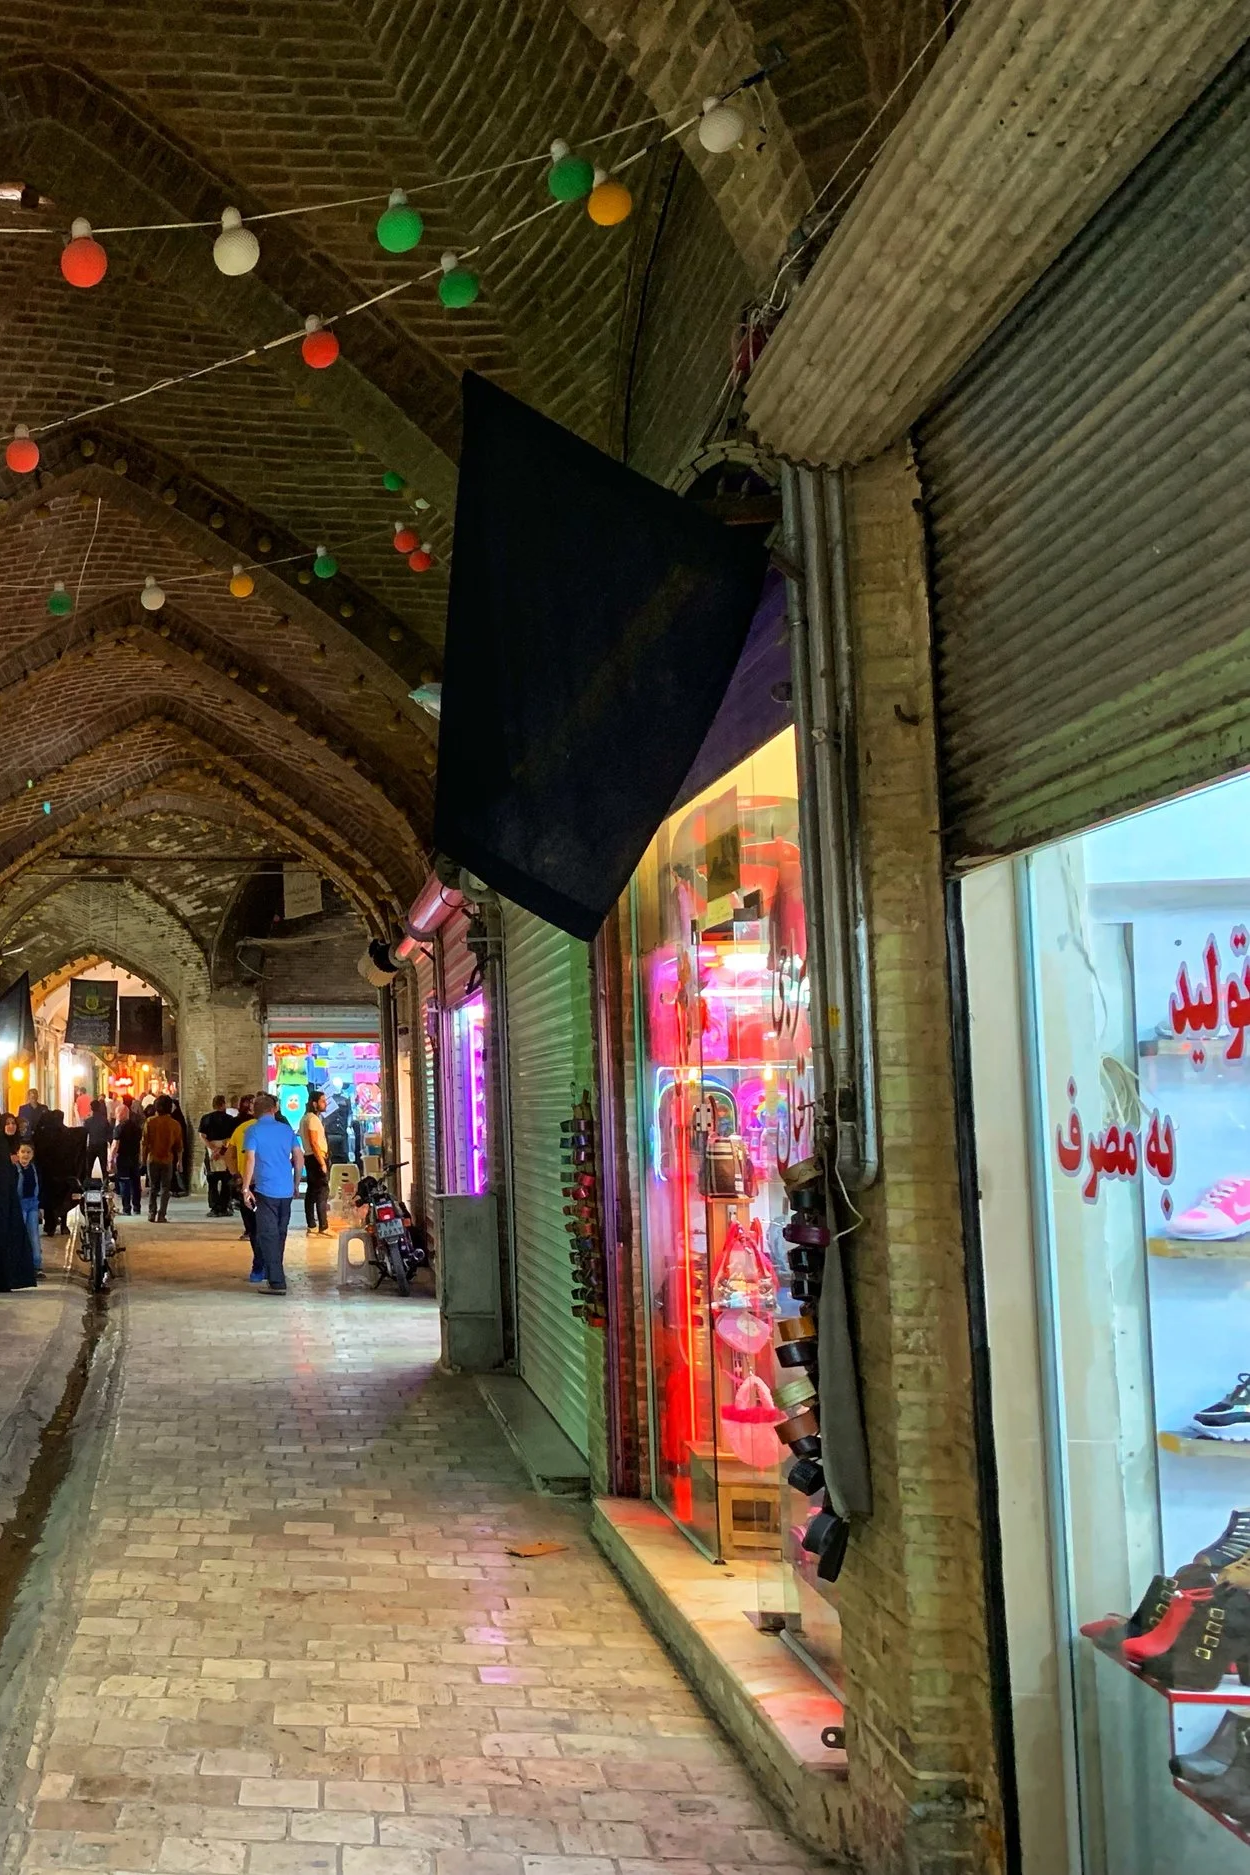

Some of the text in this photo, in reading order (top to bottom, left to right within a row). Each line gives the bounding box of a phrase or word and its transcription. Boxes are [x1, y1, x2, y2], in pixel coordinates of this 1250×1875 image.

[1170, 926, 1250, 1070] تولید
[1057, 1078, 1175, 1217] به مصرف
